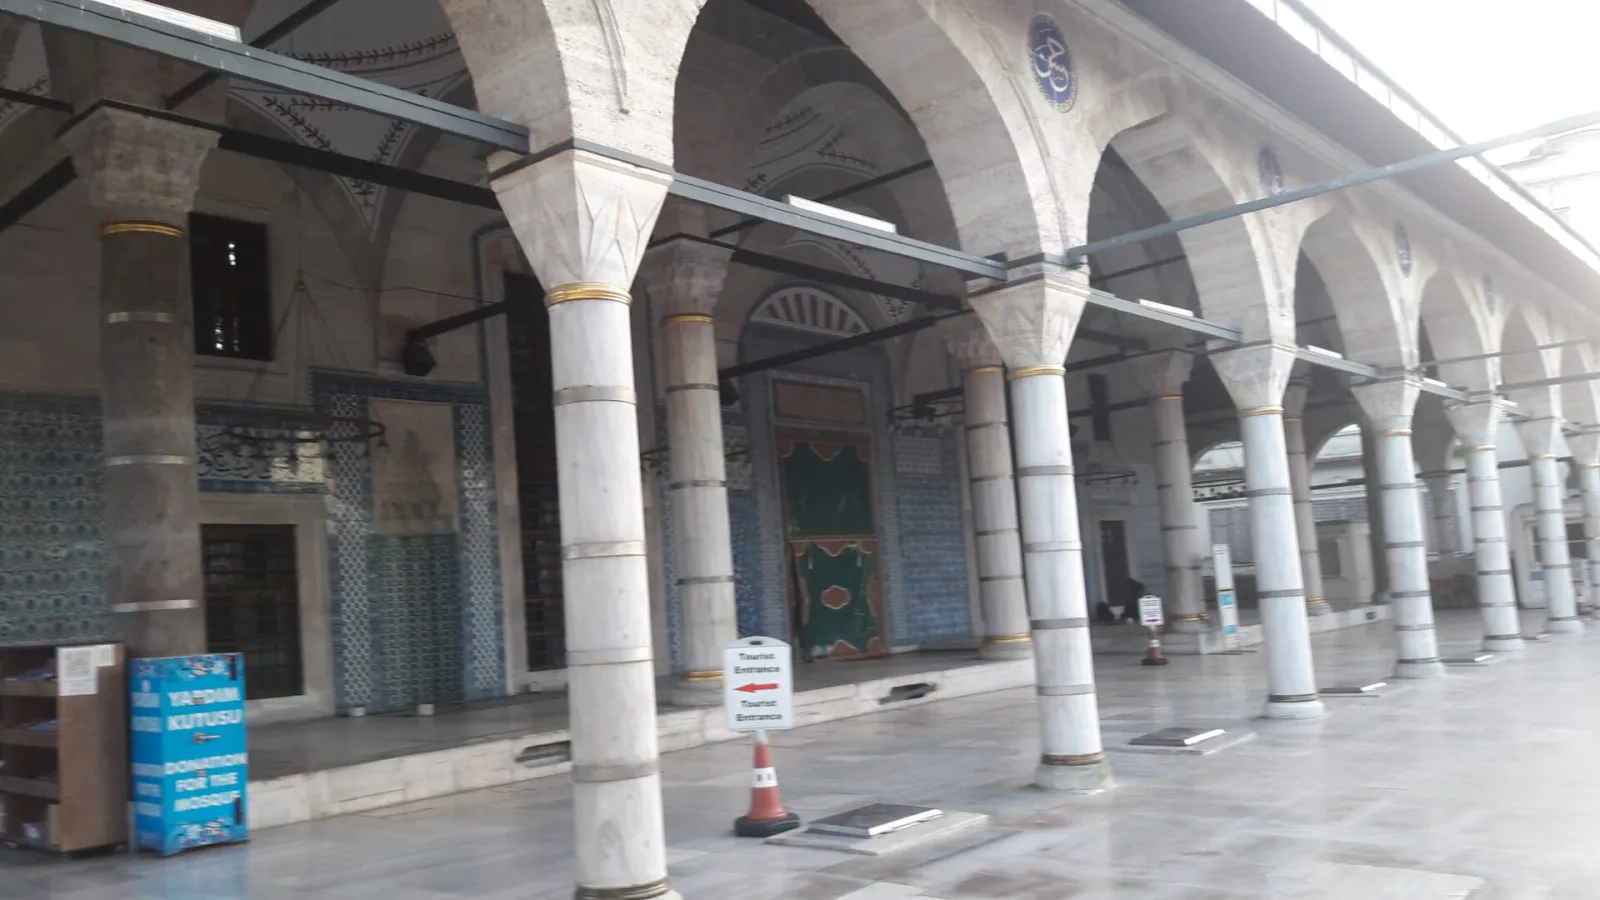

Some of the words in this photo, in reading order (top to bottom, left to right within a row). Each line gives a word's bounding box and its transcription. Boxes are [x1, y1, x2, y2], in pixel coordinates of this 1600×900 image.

[734, 666, 780, 674] Entrance
[167, 687, 240, 706] YARDIM
[741, 700, 778, 708] Tourist
[167, 709, 242, 730] KUTUSU
[736, 713, 782, 721] Entrance
[164, 752, 248, 775] DONATION
[175, 777, 207, 792] FOR
[210, 772, 238, 787] THE
[174, 790, 241, 812] MOSQUE
